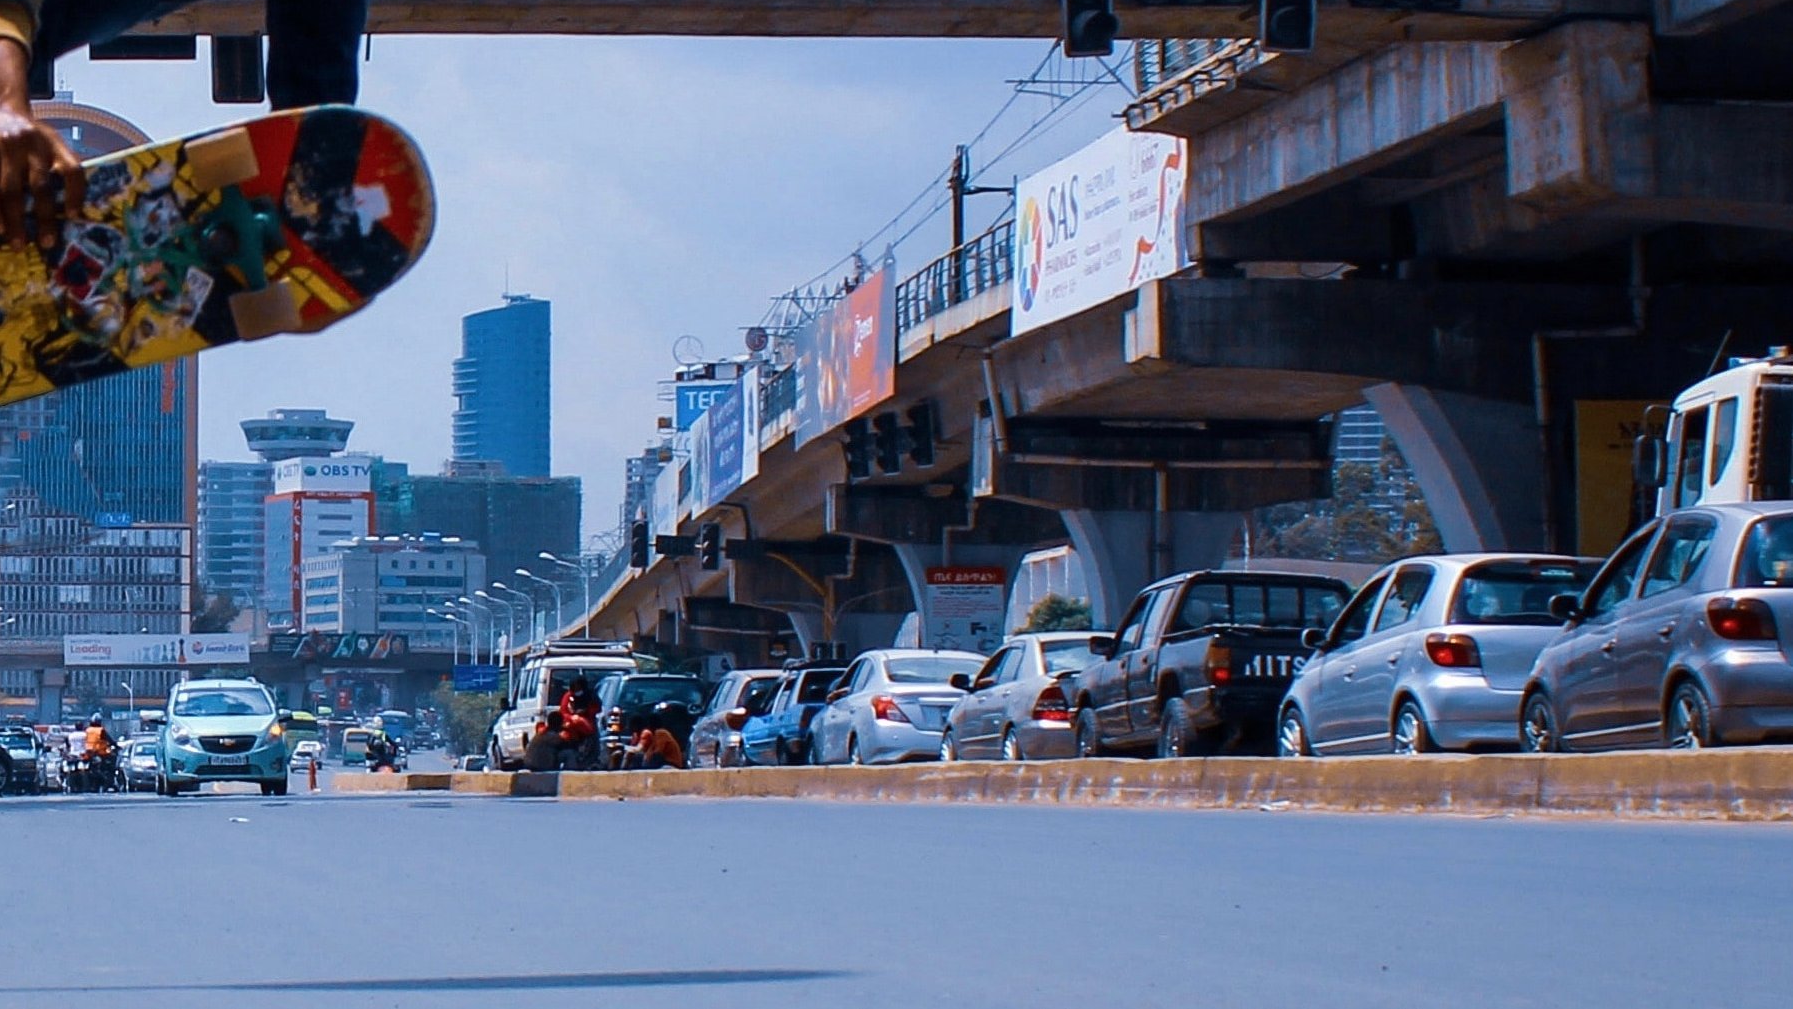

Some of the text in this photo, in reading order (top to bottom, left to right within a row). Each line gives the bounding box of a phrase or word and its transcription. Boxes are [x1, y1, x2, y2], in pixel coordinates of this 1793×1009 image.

[1046, 174, 1079, 249] SAS
[320, 464, 373, 476] OBS TV
